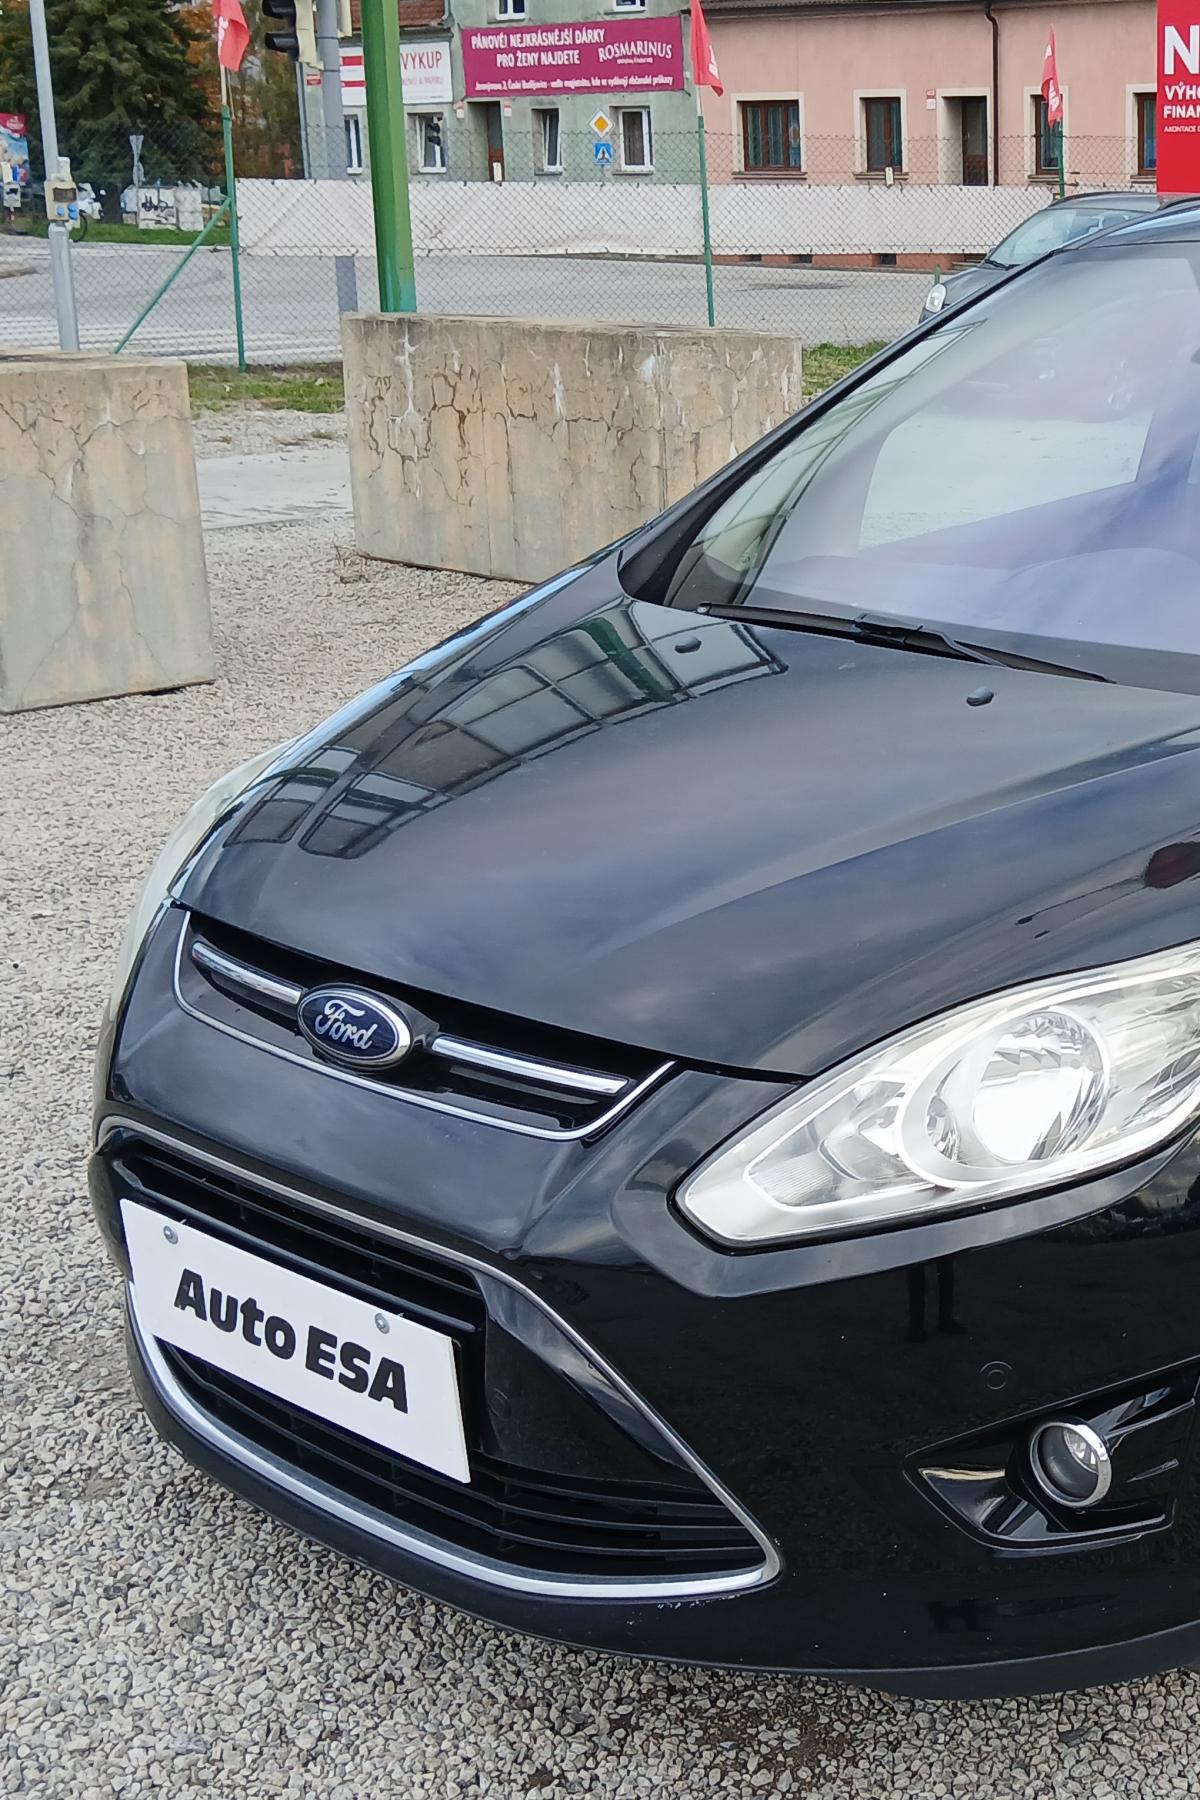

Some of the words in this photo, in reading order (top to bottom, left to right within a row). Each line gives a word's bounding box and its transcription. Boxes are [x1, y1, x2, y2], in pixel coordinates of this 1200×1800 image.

[510, 28, 573, 48] NEJKRÁSNĚJŠÍ
[575, 27, 605, 44] DÁRKY
[496, 53, 515, 68] PRO
[517, 50, 539, 67] ŽENY
[541, 50, 580, 65] NAJDETE
[598, 40, 672, 62] ROSMARINUS
[315, 1000, 378, 1049] Ford
[174, 1268, 296, 1360] Auto
[305, 1325, 408, 1414] ESA
